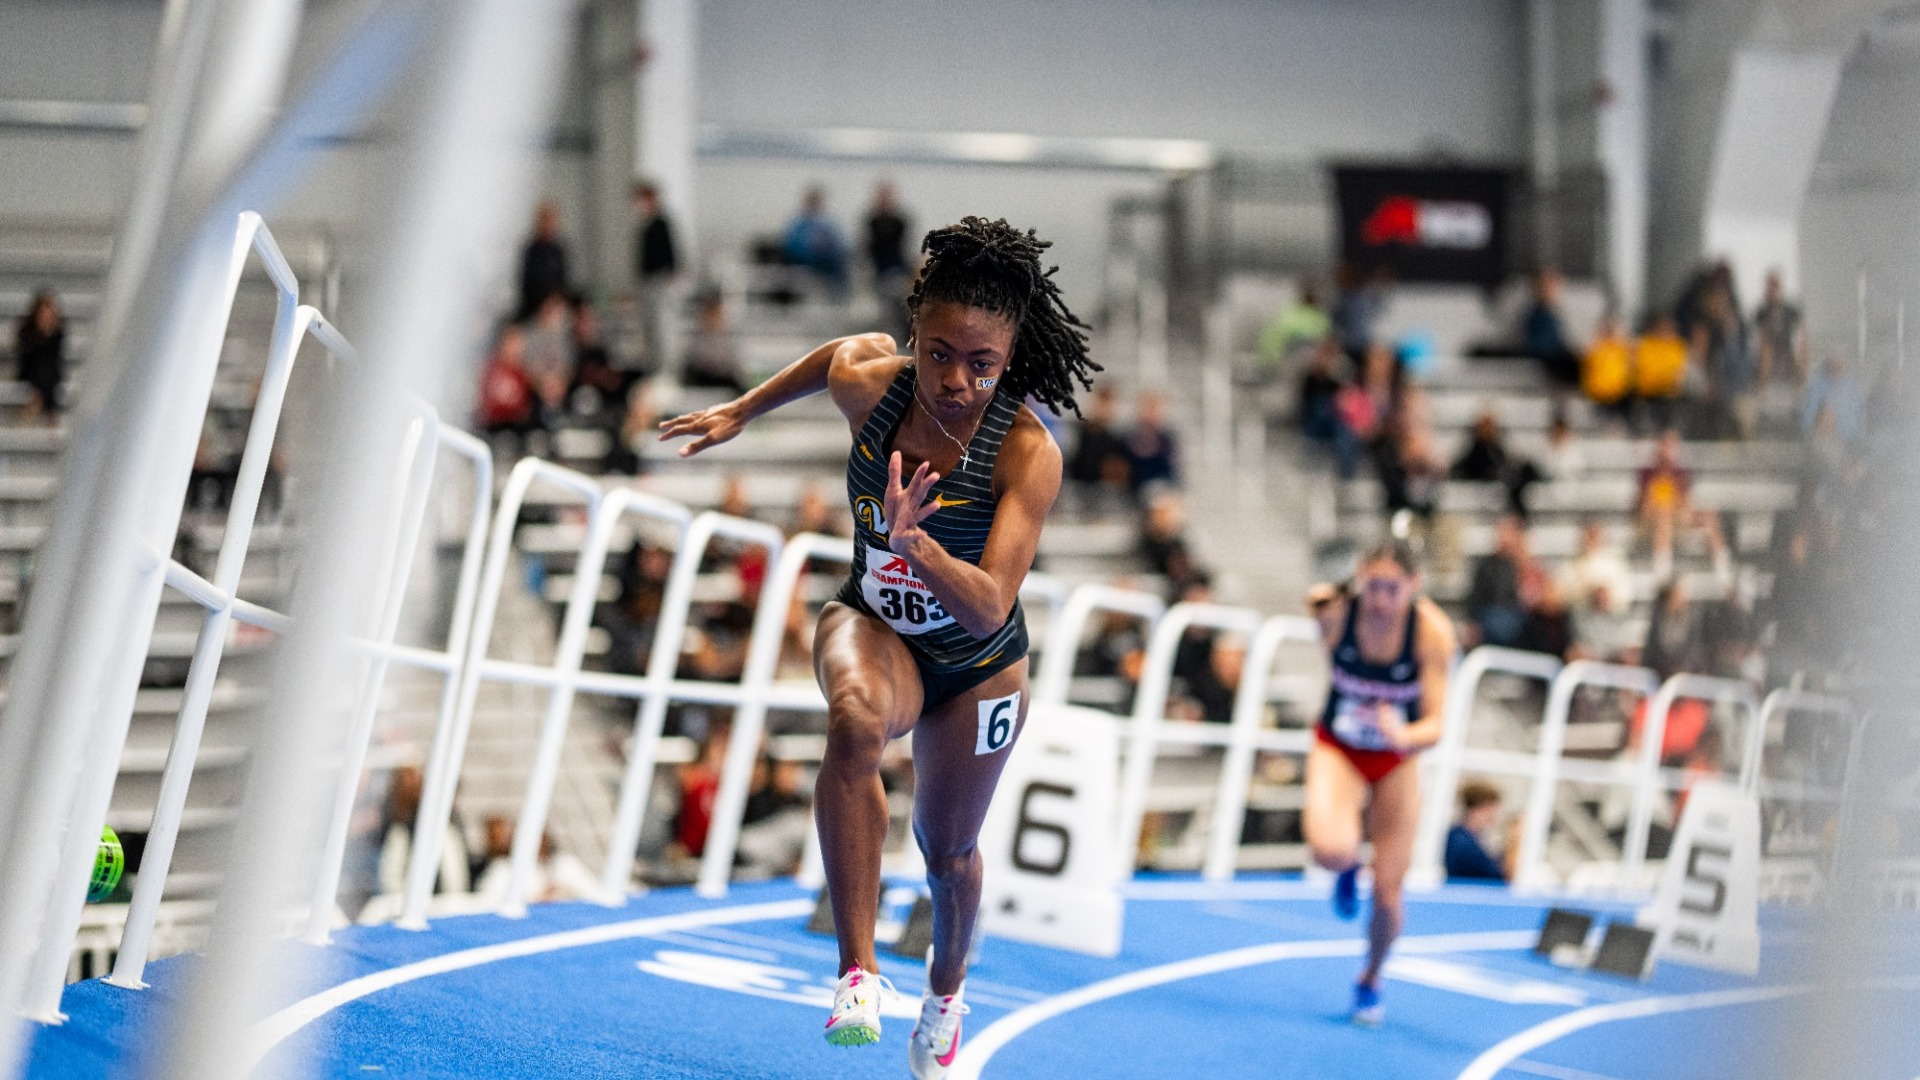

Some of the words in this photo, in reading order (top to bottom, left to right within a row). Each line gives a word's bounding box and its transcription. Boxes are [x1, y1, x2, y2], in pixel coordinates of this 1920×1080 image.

[879, 588, 951, 625] 363
[987, 699, 1011, 750] 6
[1012, 781, 1076, 877] 6
[1679, 843, 1732, 915] 5
